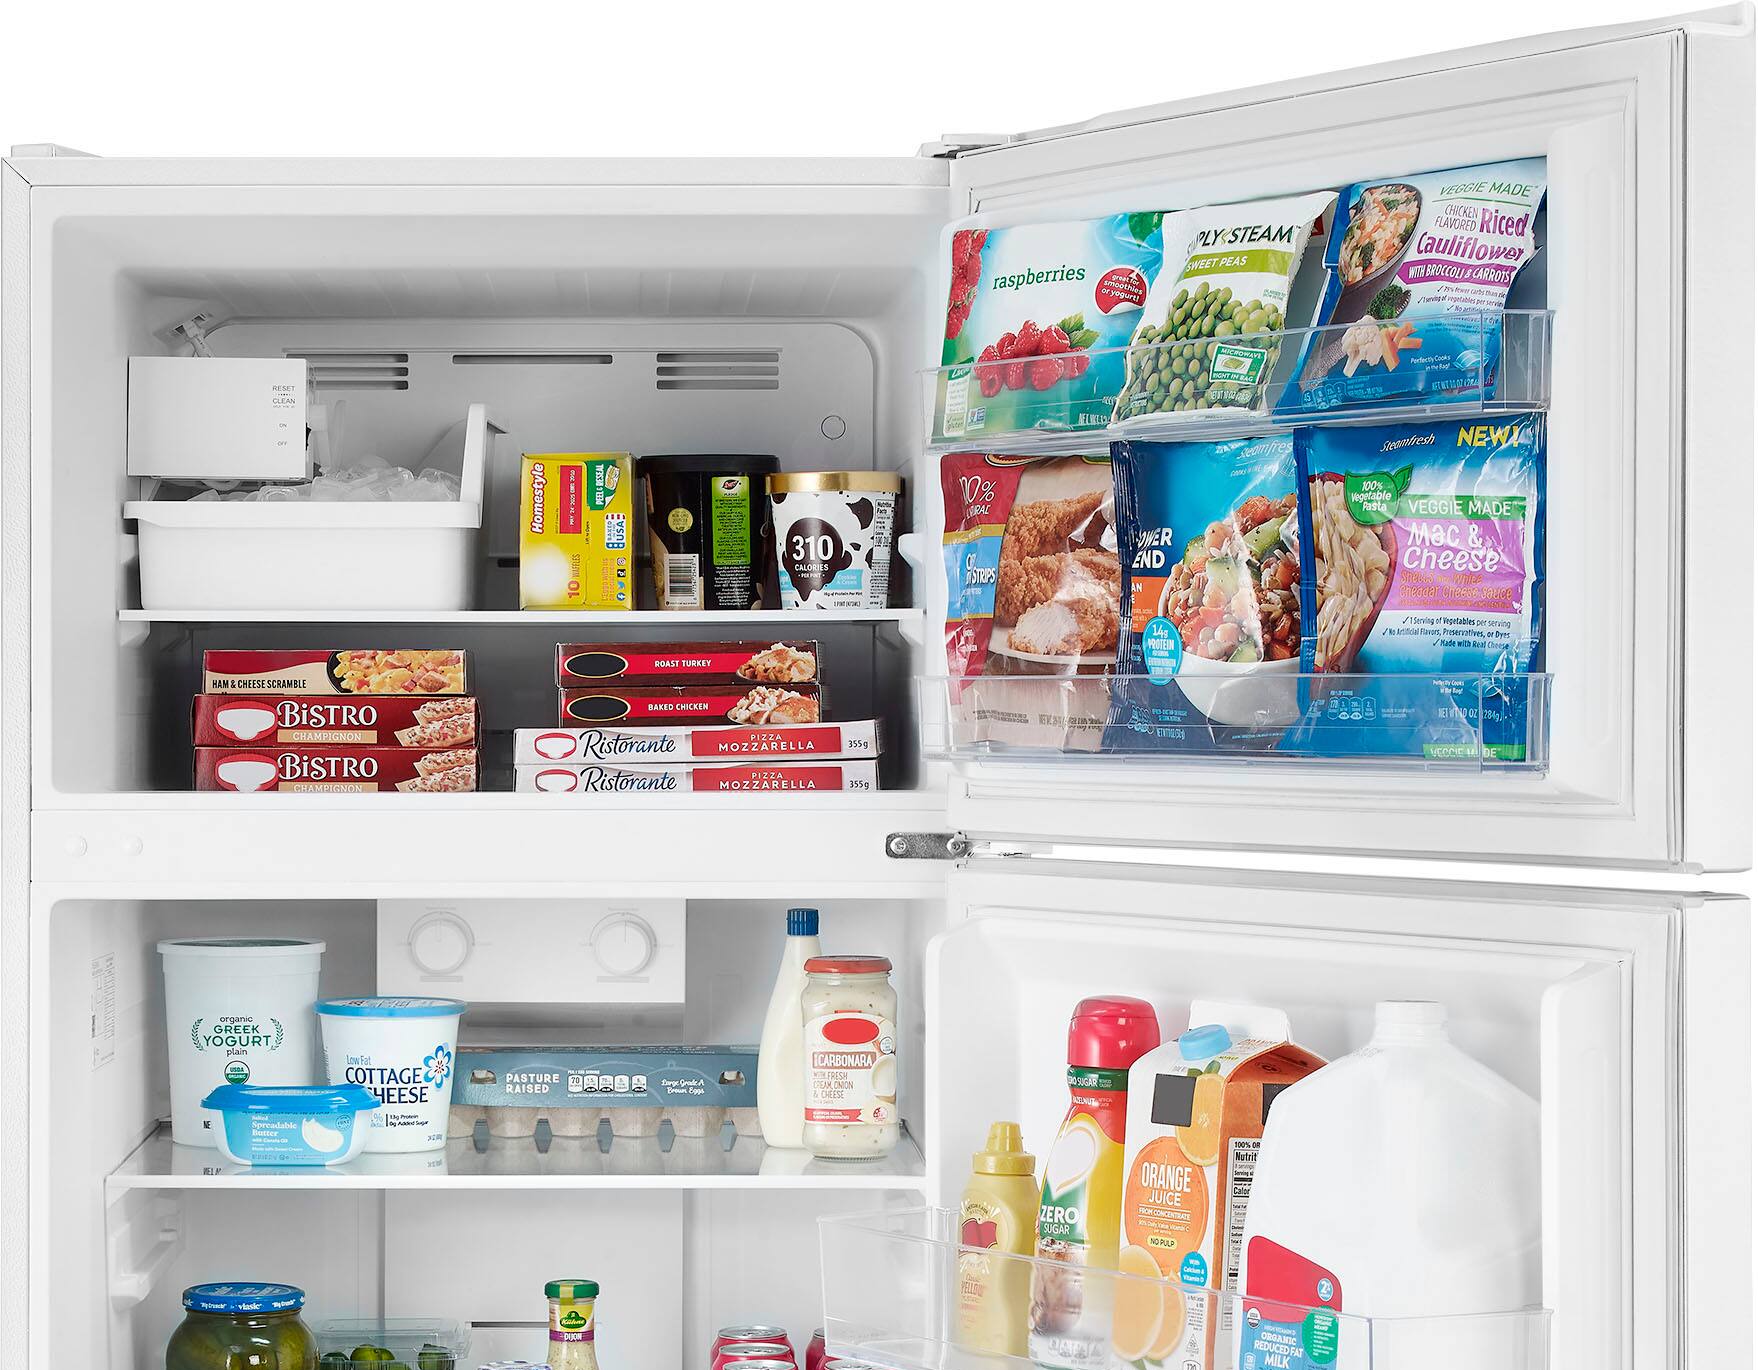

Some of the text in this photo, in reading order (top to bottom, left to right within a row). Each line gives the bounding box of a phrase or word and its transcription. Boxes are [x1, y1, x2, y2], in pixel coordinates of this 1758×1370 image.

[1440, 182, 1532, 197] VEGGIE MADE
[1445, 204, 1479, 219] CHICKEN
[1435, 208, 1530, 237] FLAVORED Riced
[1228, 225, 1294, 244] STEAM
[1416, 232, 1525, 262] Cauliflower
[1186, 256, 1248, 272] SWEET PEAS
[992, 265, 1086, 290] raspberries
[1112, 274, 1140, 286] great for
[1408, 265, 1511, 283] WITH BROCCOLI & CARROTS
[1103, 280, 1143, 295] smoothies
[1110, 289, 1140, 303] yogurt!
[1447, 296, 1476, 304] vegetables
[1221, 348, 1262, 359] MICROWAVE
[1380, 426, 1519, 452] Steamfresh NEW!
[596, 464, 605, 505] PEEL RESEAL
[1362, 480, 1384, 491] 100%
[531, 463, 547, 534] Homestyle
[1351, 490, 1392, 503] Vegetable
[1362, 501, 1387, 511] Pasta
[1408, 500, 1512, 516] VEGGIE MADE
[616, 520, 625, 541] USA
[1407, 522, 1483, 548] Mac &
[792, 535, 834, 561] 310
[571, 553, 581, 578] WAFFLES
[1403, 546, 1500, 573] Cheese
[794, 563, 829, 572] CALORIES
[971, 568, 996, 584] STRIPS
[568, 579, 580, 599] 10
[1400, 585, 1513, 600] Cheddar Cheese Sauce
[1413, 617, 1435, 626] Serving
[1443, 617, 1476, 627] Vegetables
[1488, 620, 1511, 629] serving
[1152, 624, 1169, 638] 14g
[1388, 628, 1396, 636] No
[1396, 628, 1420, 636] Artificial
[1420, 628, 1442, 637] Flavors,
[1443, 628, 1484, 638] Preservatives,
[1495, 631, 1510, 639] Dyes
[1148, 638, 1174, 650] PROTEIN
[1440, 640, 1509, 650] Made with Real Cheese
[654, 659, 712, 668] ROAST TURKEY
[212, 679, 307, 689] HAM & CHEESE SCRAMBLE
[648, 703, 709, 711] BAKED CHICKEN
[292, 731, 362, 741] CHAMPIGNON
[750, 733, 782, 741] PIZZA
[579, 729, 676, 760] Ristorante
[718, 739, 869, 752] MOZZARELLA 355g
[580, 766, 677, 792] Ristorante
[719, 779, 870, 790] MOZZARELLA 355g
[293, 784, 363, 793] CHAMPIGNON
[219, 1015, 253, 1024] organic
[213, 1025, 260, 1034] GREEK
[203, 1035, 271, 1047] YOGURT
[226, 1047, 248, 1057] plain
[346, 1054, 372, 1066] Low Fat
[818, 1054, 873, 1067] CARBONARA
[345, 1066, 422, 1085] COTTAGE
[506, 1073, 560, 1084] PASTURE
[571, 1076, 580, 1084] 70
[827, 1071, 848, 1080] FRESH
[506, 1083, 549, 1094] RAISED
[661, 1078, 679, 1087] Large
[680, 1078, 697, 1087] Grade
[833, 1080, 854, 1090] ONION
[1077, 1077, 1098, 1088] SUGAR
[367, 1086, 429, 1104] HEESE
[667, 1086, 705, 1095] Brown Eggs
[821, 1090, 845, 1099] CHEESE
[252, 1120, 297, 1130] Spreadable
[1141, 1161, 1193, 1192] ORANGE
[1148, 1190, 1182, 1207] JUICE
[1040, 1205, 1080, 1224] ZERO
[1138, 1207, 1191, 1221] FROM CONCENTRATE
[1044, 1223, 1070, 1235] SUGAR
[1150, 1238, 1175, 1248] NO PULP
[1183, 1266, 1200, 1274] Calcium
[564, 1332, 582, 1341] DIJON
[1261, 1332, 1297, 1345] ORGANIC
[1254, 1340, 1304, 1358] REDUCED FAT
[1264, 1353, 1291, 1369] MILK
